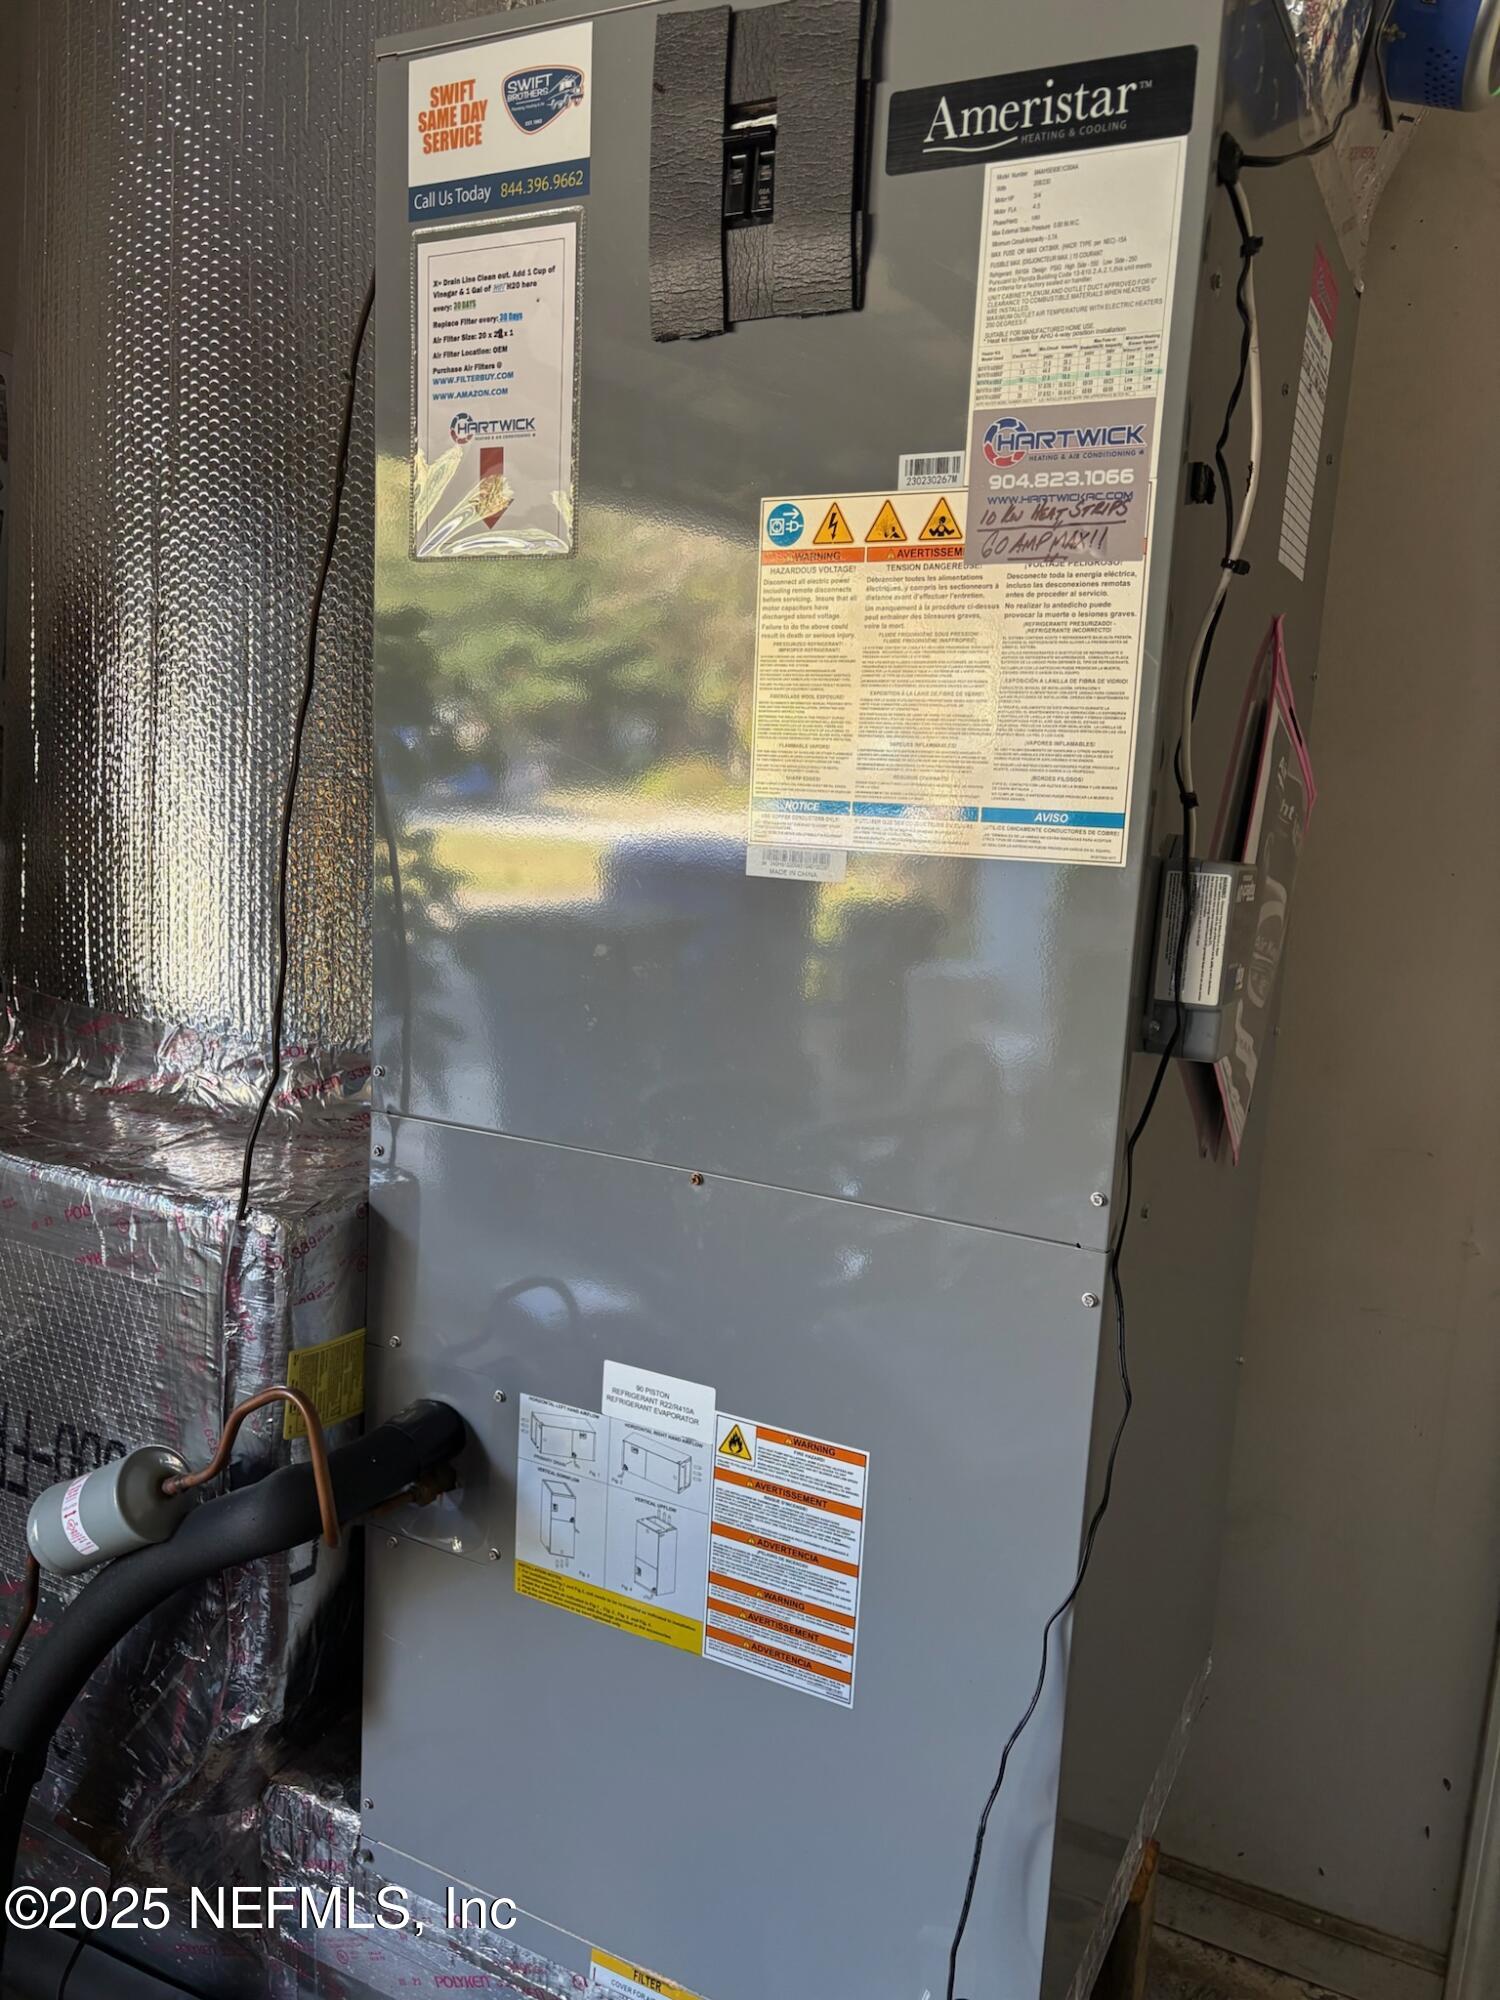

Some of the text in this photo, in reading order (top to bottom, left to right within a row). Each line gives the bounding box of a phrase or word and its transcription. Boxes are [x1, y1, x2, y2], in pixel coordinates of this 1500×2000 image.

[508, 73, 552, 93] SWIFT
[430, 79, 475, 108] SWIFT
[507, 88, 548, 101] BROTHERS
[418, 107, 456, 133] SAME
[460, 99, 488, 124] DAY
[423, 124, 482, 154] SERVICE
[1020, 120, 1127, 144] HEATING & COOLING
[414, 170, 583, 209] Call Us Today 844.396.9662
[444, 278, 460, 286] Drain
[533, 267, 546, 276] Cup
[548, 265, 555, 273] of
[433, 290, 457, 299] Vinegar
[433, 319, 458, 328] Replace
[461, 318, 477, 326] Filter
[443, 335, 459, 343] Filter
[462, 348, 491, 356] Location:
[433, 366, 462, 374] Purchase
[433, 371, 514, 385] WWW.FILTERBUY.COM
[433, 388, 508, 400] WWW.AMAZON.COM
[457, 417, 535, 434] HARTWICK
[997, 423, 1147, 451] HARTWICK
[1029, 450, 1136, 462] HEATING & AIR CONDITIONING
[906, 476, 957, 486] 230230267M
[988, 469, 1134, 490] 904.823.1066
[987, 491, 1134, 505] WWW.HARTWICKAC.COM
[980, 509, 997, 525] 10
[1031, 501, 1069, 520] HEAT
[1069, 499, 1131, 518] STRIPS
[981, 529, 1008, 559] 60
[1009, 530, 1052, 553] AMP
[794, 552, 841, 562] WARNING
[770, 565, 857, 574] HAZARDOUS VOLTAGE!
[1007, 572, 1047, 580] Desconecte
[1075, 571, 1102, 579] energía
[1104, 570, 1137, 578] eléctrica,
[784, 801, 819, 811] NOTICE
[1034, 812, 1069, 823] AVISO
[612, 1387, 658, 1405] REFRIGERANT
[645, 1387, 670, 1400] PISTON
[606, 1394, 653, 1412] REFRIGERANT
[654, 1407, 699, 1425] EVAPORATOR
[793, 1437, 836, 1456] WARNING
[755, 1481, 828, 1508] AVERTISSEMENT
[757, 1538, 819, 1563] ADVERTENCIA
[764, 1591, 805, 1611] WARNING
[748, 1613, 820, 1641] AVERTISSEMENT
[752, 1643, 812, 1669] ADVERTENCIA
[611, 1979, 632, 1995] COVER
[633, 1969, 661, 1993] FILTER
